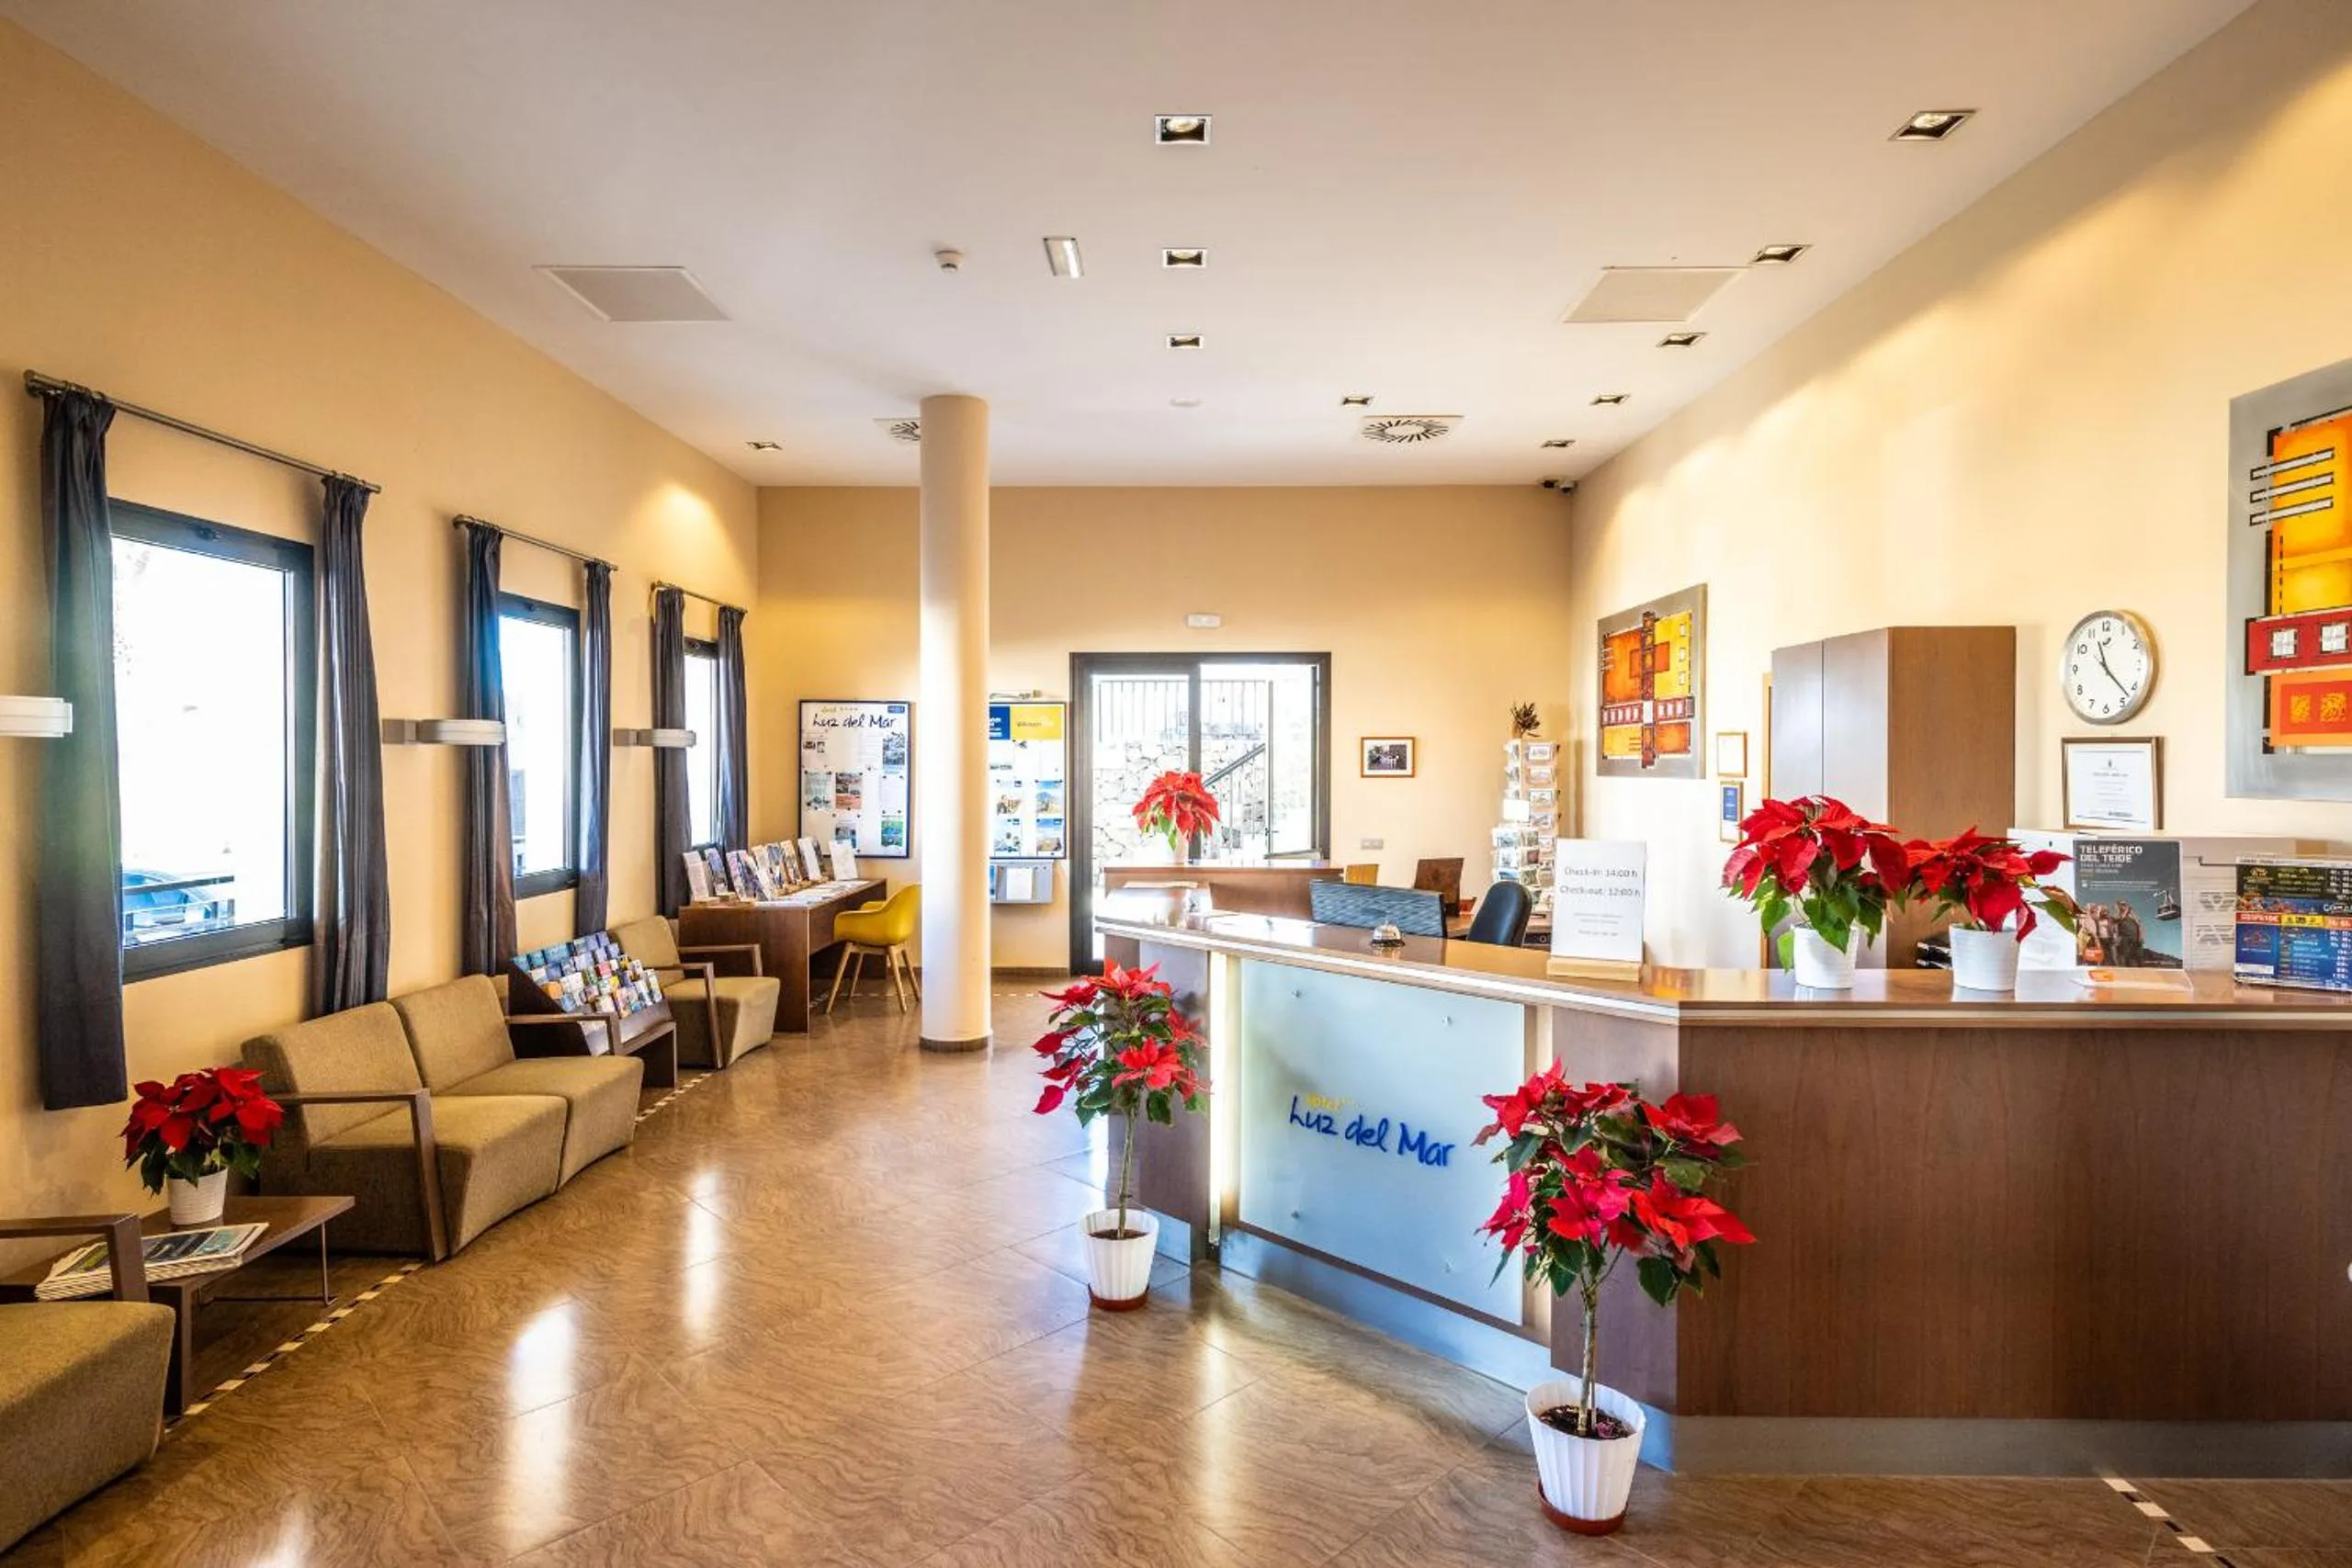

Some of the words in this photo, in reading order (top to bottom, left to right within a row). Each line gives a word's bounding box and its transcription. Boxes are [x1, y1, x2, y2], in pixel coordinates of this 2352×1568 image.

[2102, 621, 2111, 632] 12
[2088, 628, 2096, 638] 11
[2077, 644, 2087, 655] 10
[2102, 704, 2109, 715] 6
[812, 713, 840, 728] Luz
[842, 713, 865, 728] del
[869, 715, 898, 728] Mar
[2080, 843, 2143, 855] TELEFÉRICO
[2080, 854, 2100, 863] DEL
[2102, 854, 2132, 863] TEIDE
[1290, 1095, 1339, 1135] Luz
[1344, 1113, 1387, 1153] del
[1396, 1122, 1456, 1168] Mar
